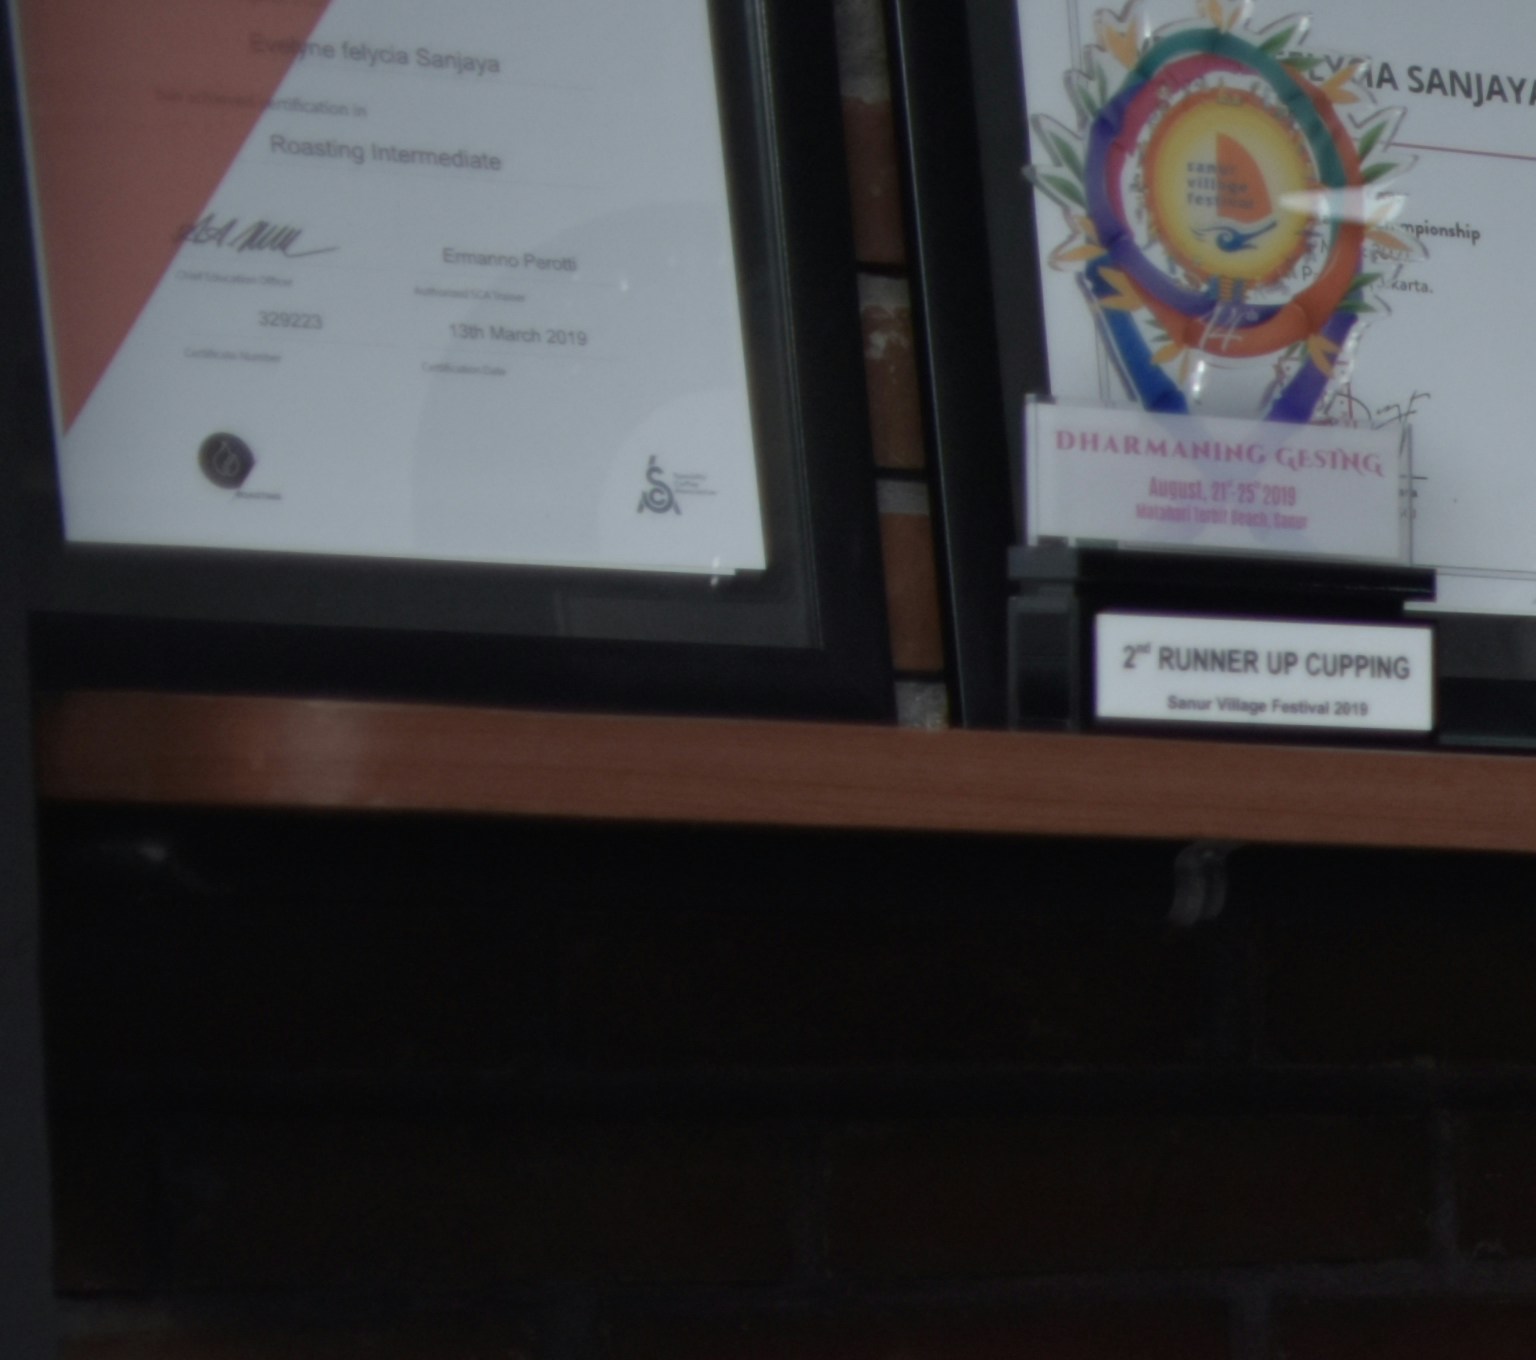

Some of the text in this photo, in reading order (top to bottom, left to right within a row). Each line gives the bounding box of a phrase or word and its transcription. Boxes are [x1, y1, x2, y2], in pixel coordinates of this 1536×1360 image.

[249, 33, 501, 76] Evelyne felycia Sanjaya
[269, 133, 502, 171] Roasting Intermediate
[441, 247, 578, 273] Ermanno Perotti
[257, 309, 323, 330] 329223
[449, 321, 589, 347] 13th March 2019
[1056, 430, 1267, 465] DHARMANING
[1149, 476, 1208, 502] August,
[1262, 484, 1298, 507] 2019
[1122, 642, 1411, 681] 2nd RUNNER UP CUPPING
[1166, 694, 1370, 717] Sanur Village Festival 2019
